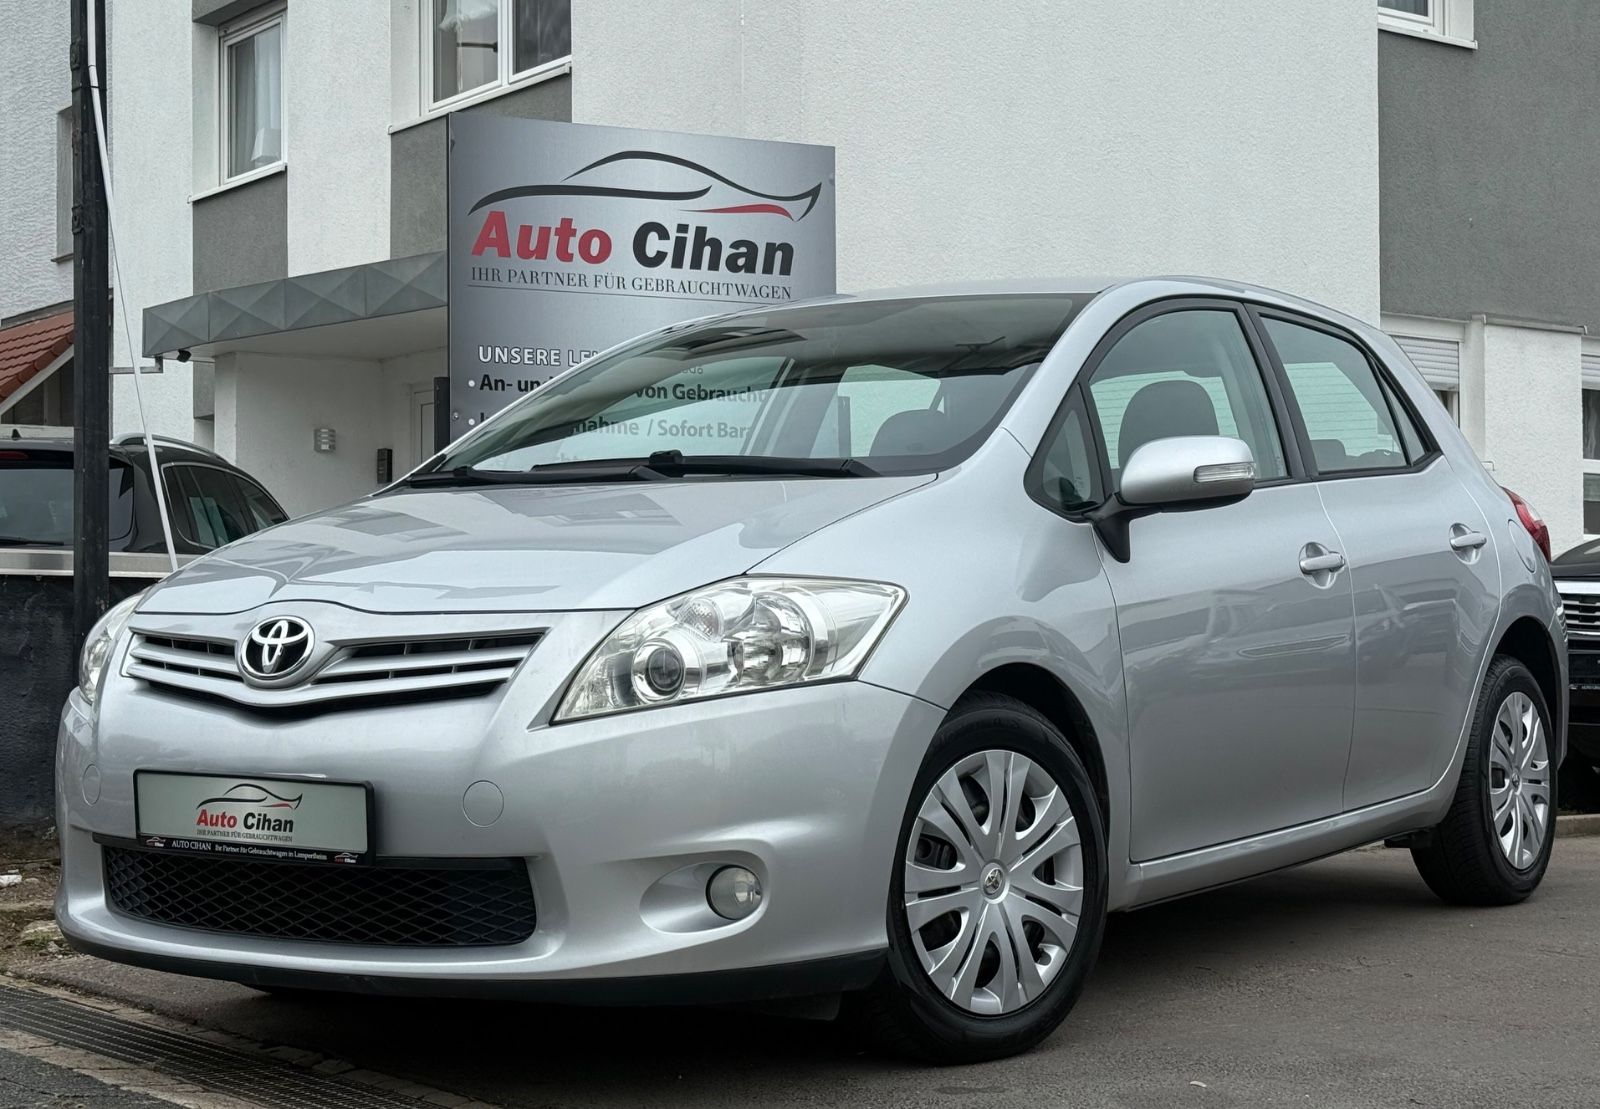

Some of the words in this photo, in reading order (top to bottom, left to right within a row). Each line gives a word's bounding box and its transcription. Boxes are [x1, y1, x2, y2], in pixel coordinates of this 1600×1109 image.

[471, 210, 613, 265] Auto
[632, 221, 795, 277] Cihan
[471, 267, 503, 283] IHR
[507, 269, 588, 289] PARTNER
[593, 272, 627, 291] FÜR
[631, 276, 792, 300] GEBRAUCHTWAGEN
[478, 345, 562, 367] UNSERE
[568, 350, 599, 367] LE
[479, 373, 513, 392] An-
[672, 383, 766, 403] Gebraucht
[657, 418, 713, 439] Sofort
[196, 809, 238, 829] Auto
[243, 812, 294, 833] Cihan
[171, 839, 189, 849] AUTO
[190, 841, 212, 851] CIHAN
